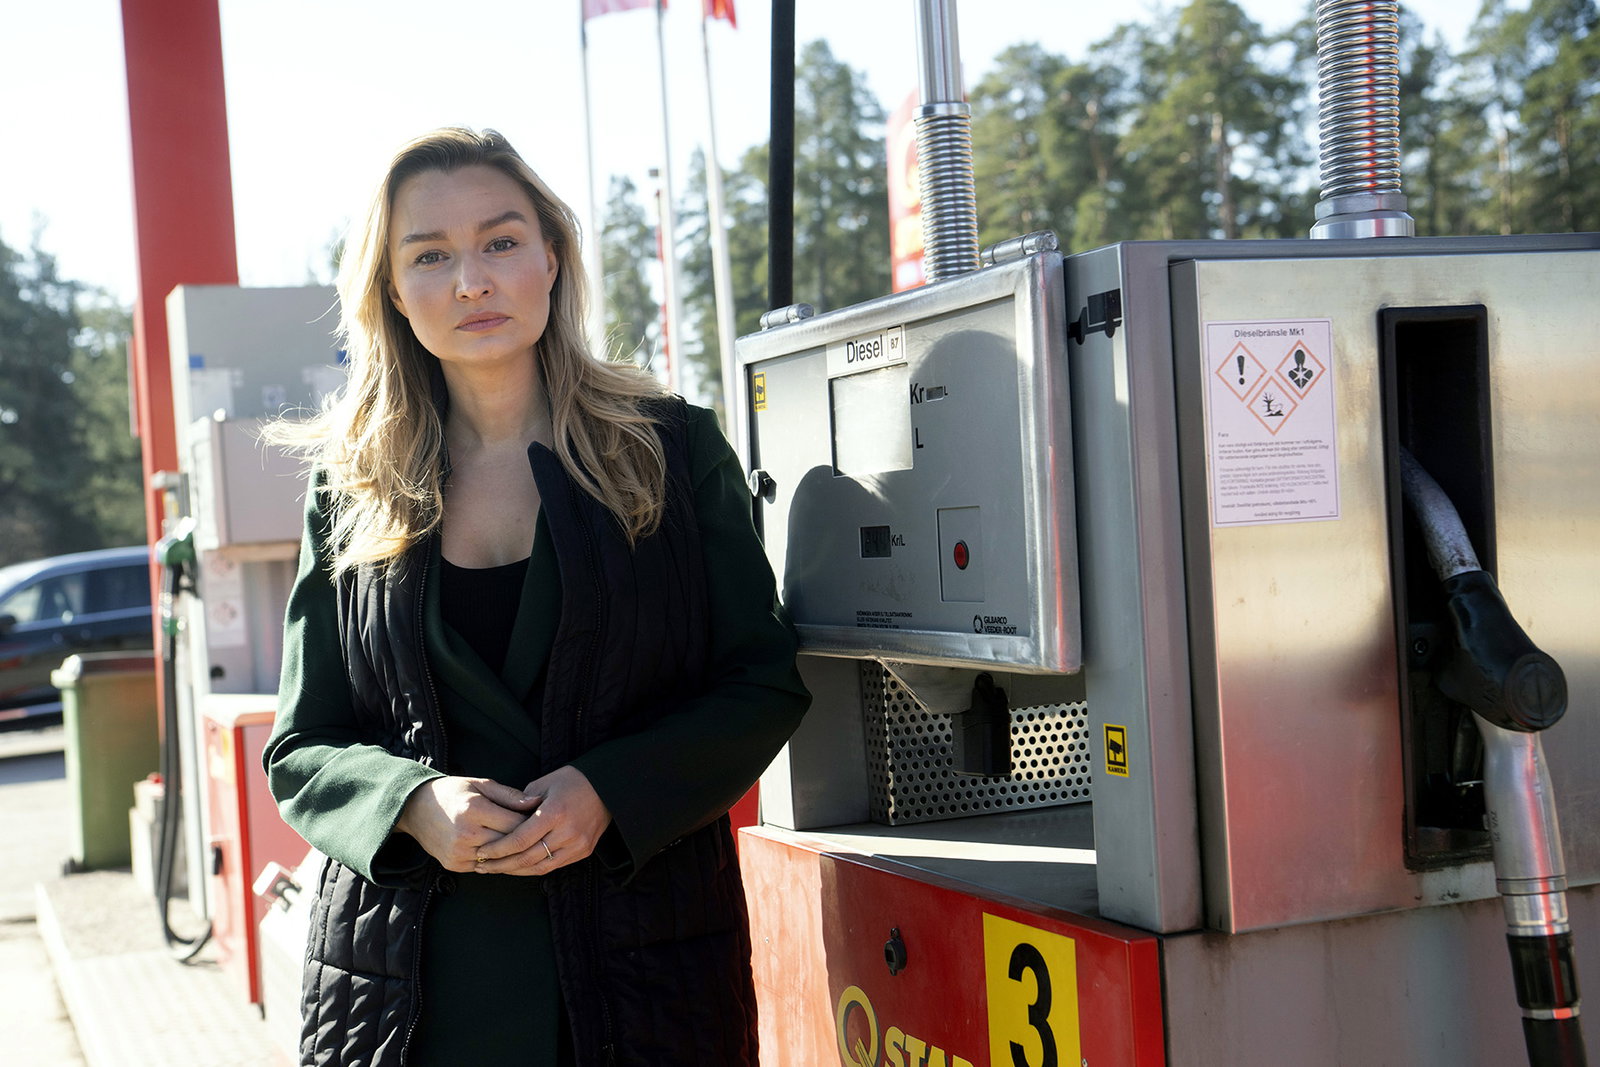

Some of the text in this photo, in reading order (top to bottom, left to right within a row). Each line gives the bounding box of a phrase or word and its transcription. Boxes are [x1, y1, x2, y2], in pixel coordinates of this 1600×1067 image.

[1234, 327, 1305, 338] Dieselbränsle Mk1
[846, 334, 884, 363] Diesel
[909, 383, 949, 405] Kr L
[915, 427, 924, 449] L
[1008, 942, 1058, 1067] 3
